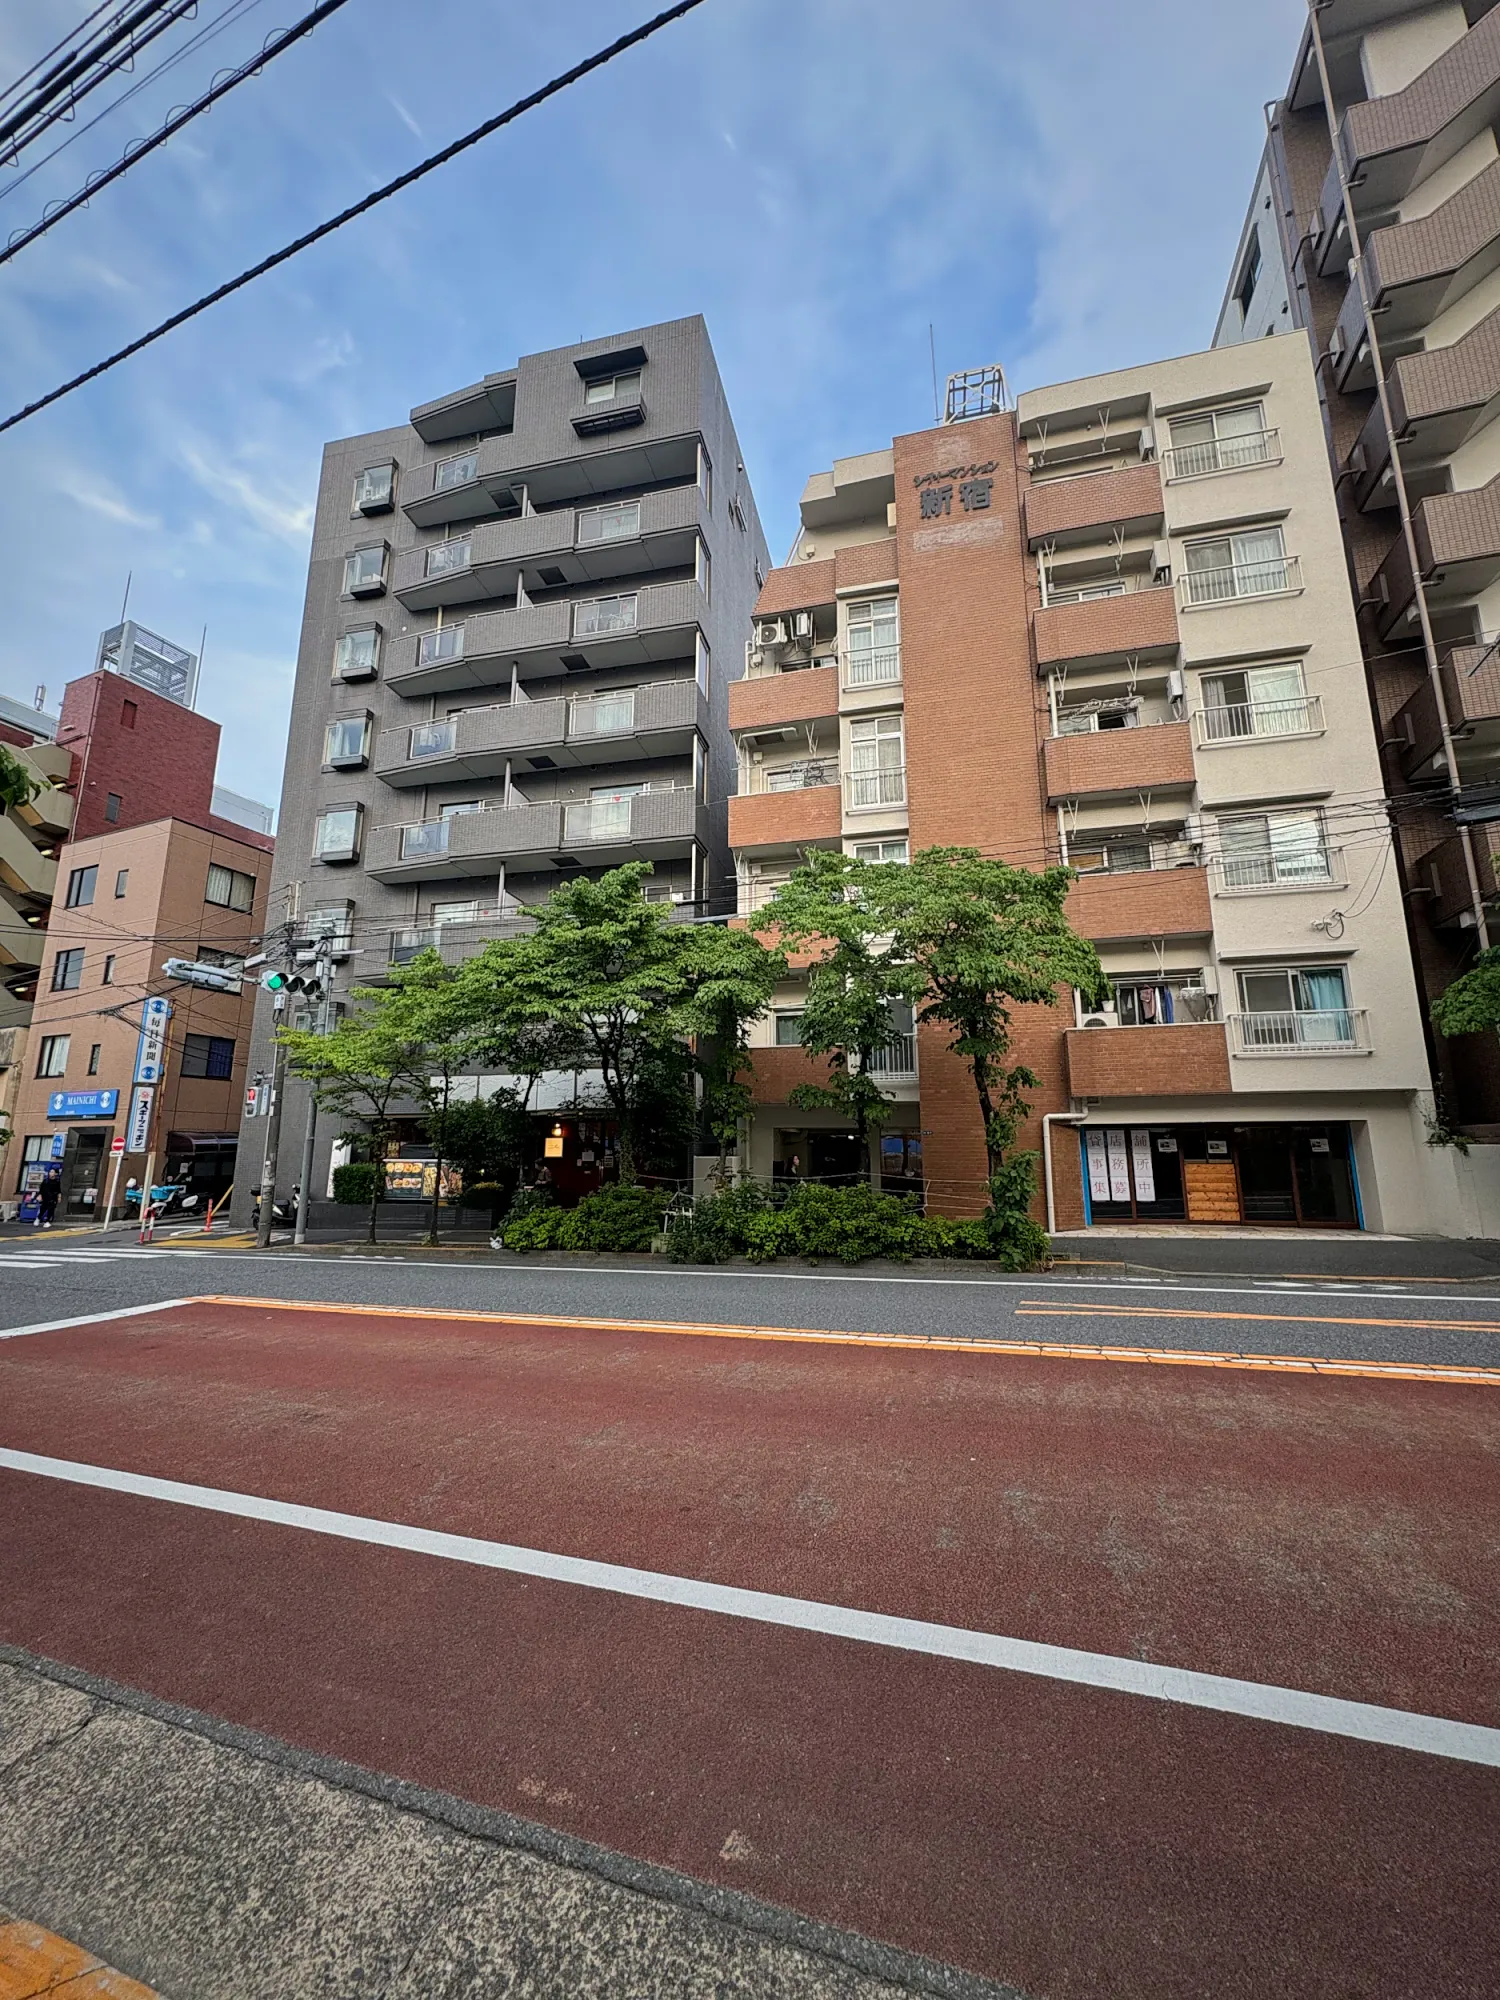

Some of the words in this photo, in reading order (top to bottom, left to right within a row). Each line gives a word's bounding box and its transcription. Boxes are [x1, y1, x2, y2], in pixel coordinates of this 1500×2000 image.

[920, 478, 993, 519] 新宿
[146, 1017, 161, 1061] 毎日新聞
[66, 1095, 97, 1105] MAINICHI
